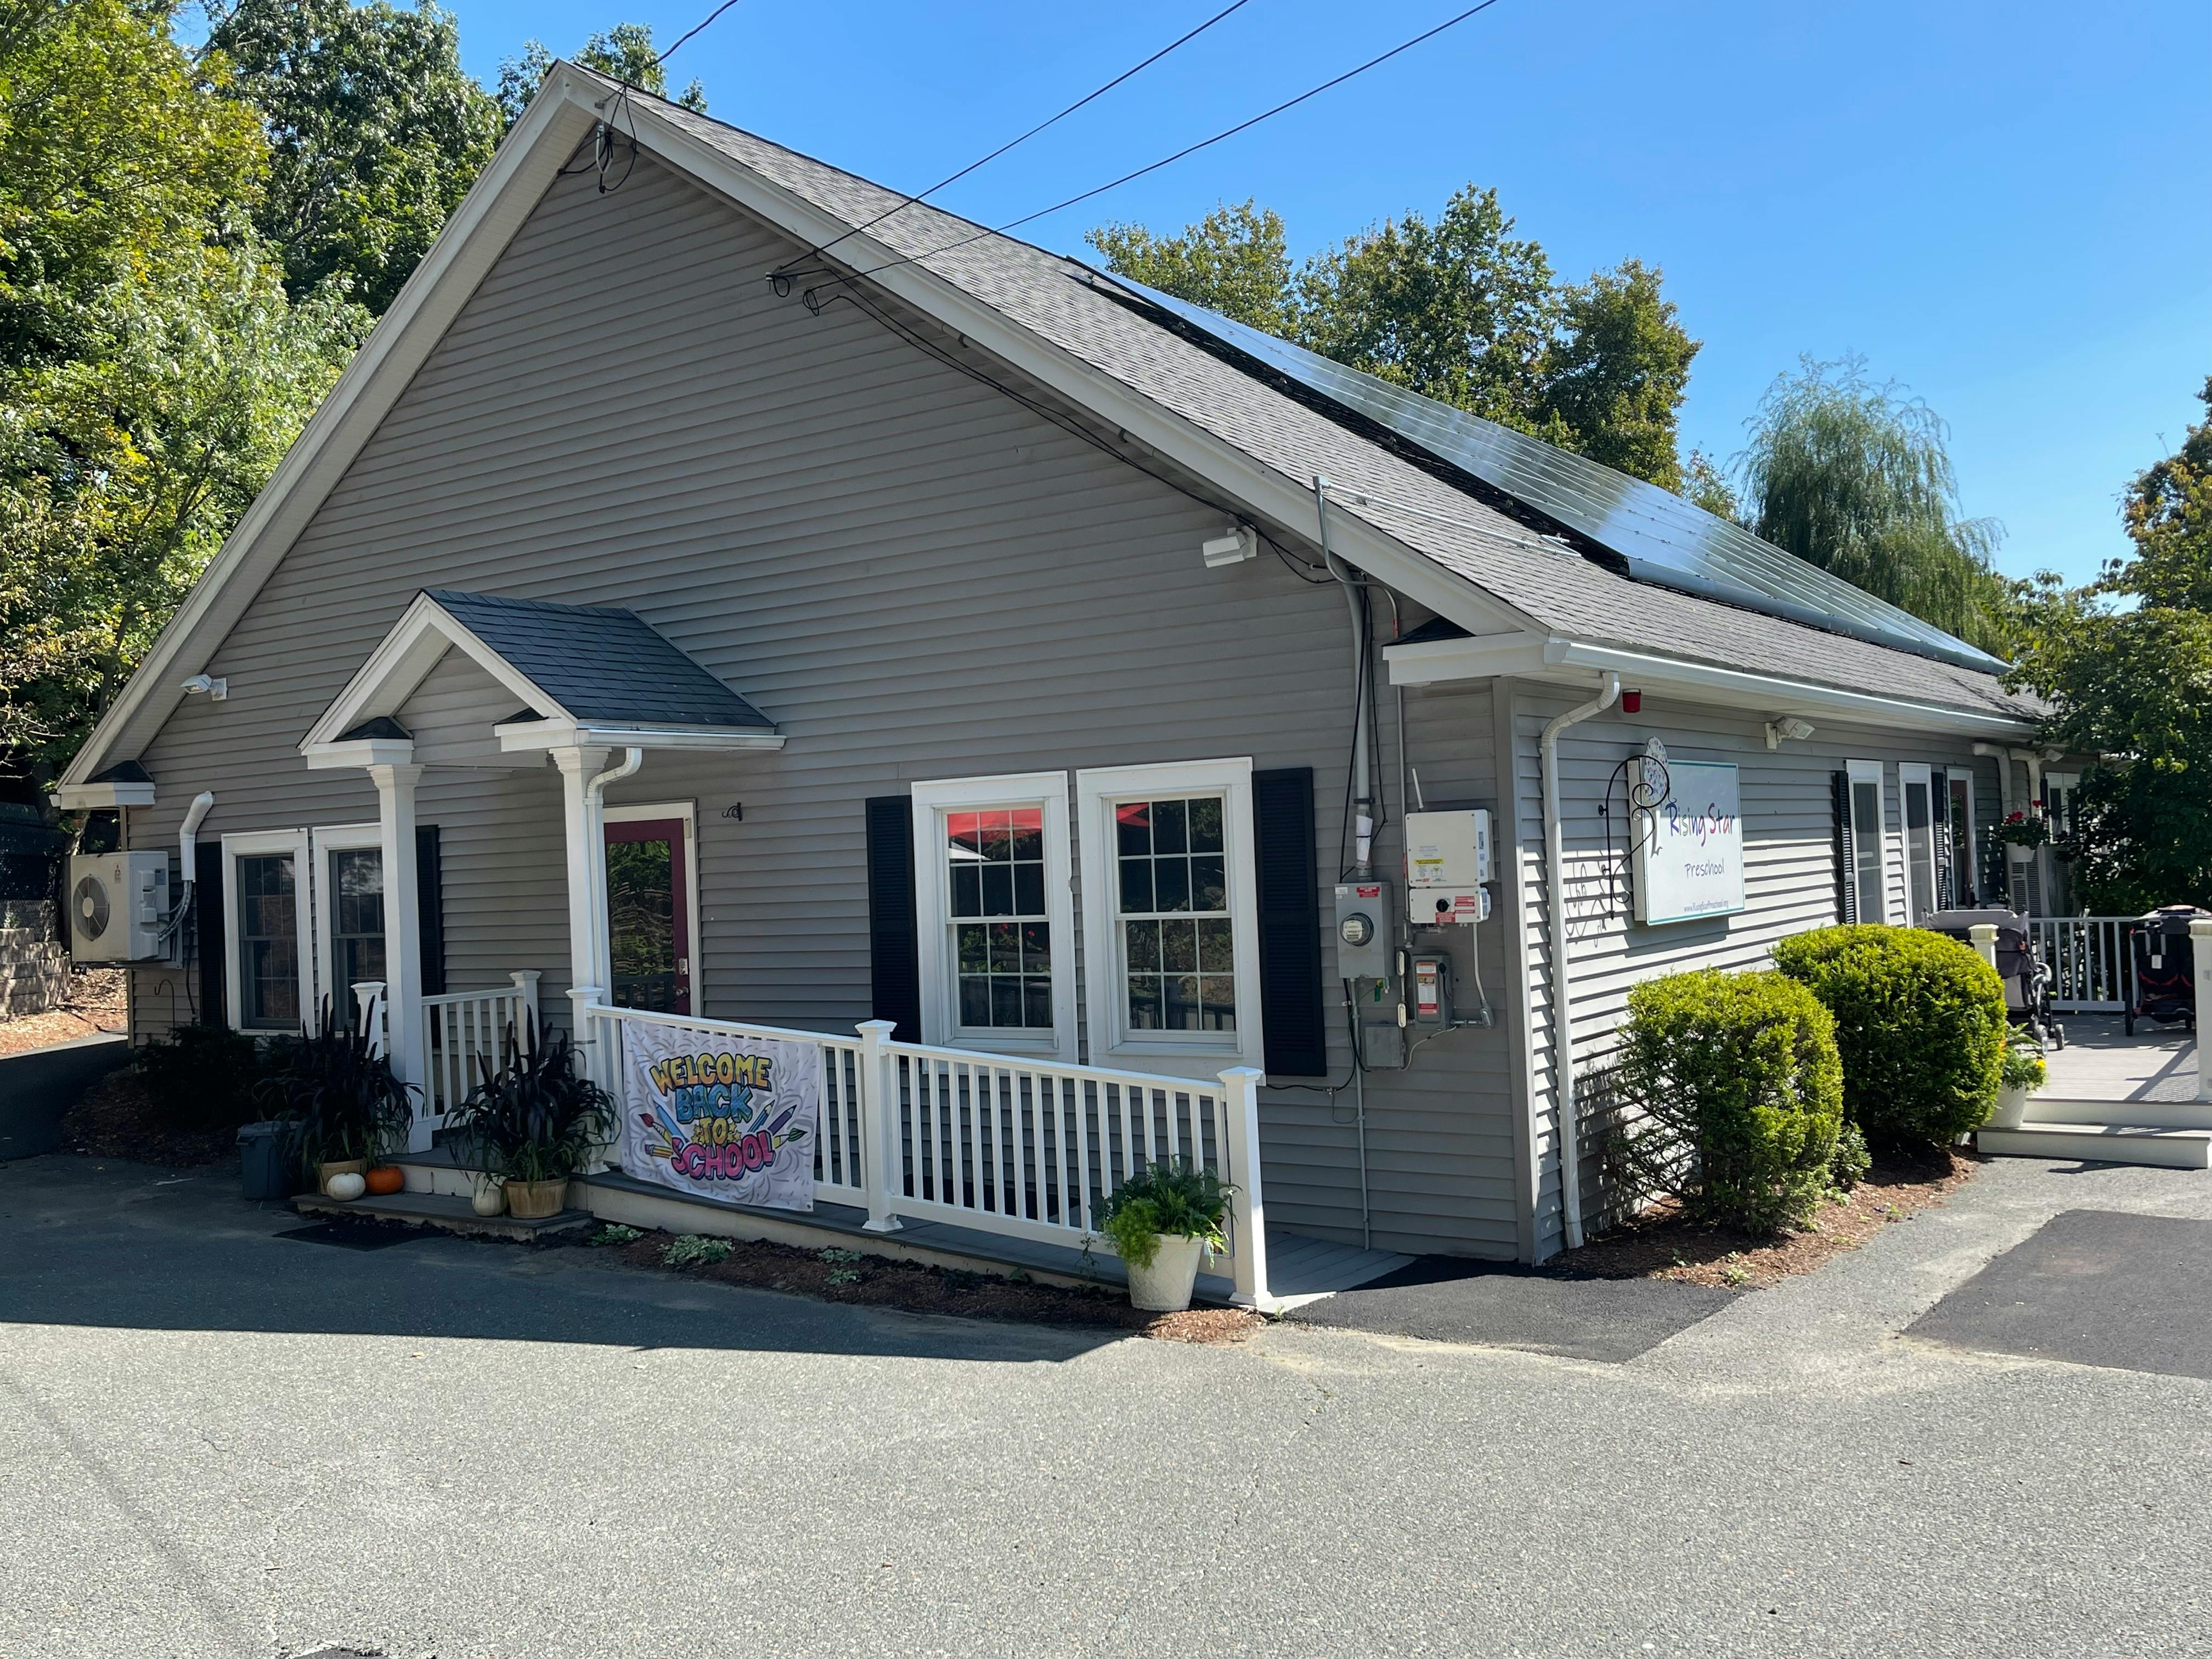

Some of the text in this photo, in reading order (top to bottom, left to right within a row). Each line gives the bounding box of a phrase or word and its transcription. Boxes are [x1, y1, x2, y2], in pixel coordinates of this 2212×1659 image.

[1665, 803, 1735, 847] Rising Star
[1684, 857, 1725, 878] Preschool
[650, 1052, 773, 1096] WELCOME
[675, 1084, 753, 1124] BACK
[699, 1118, 728, 1146] TO
[671, 1130, 776, 1181] SCHOOL
